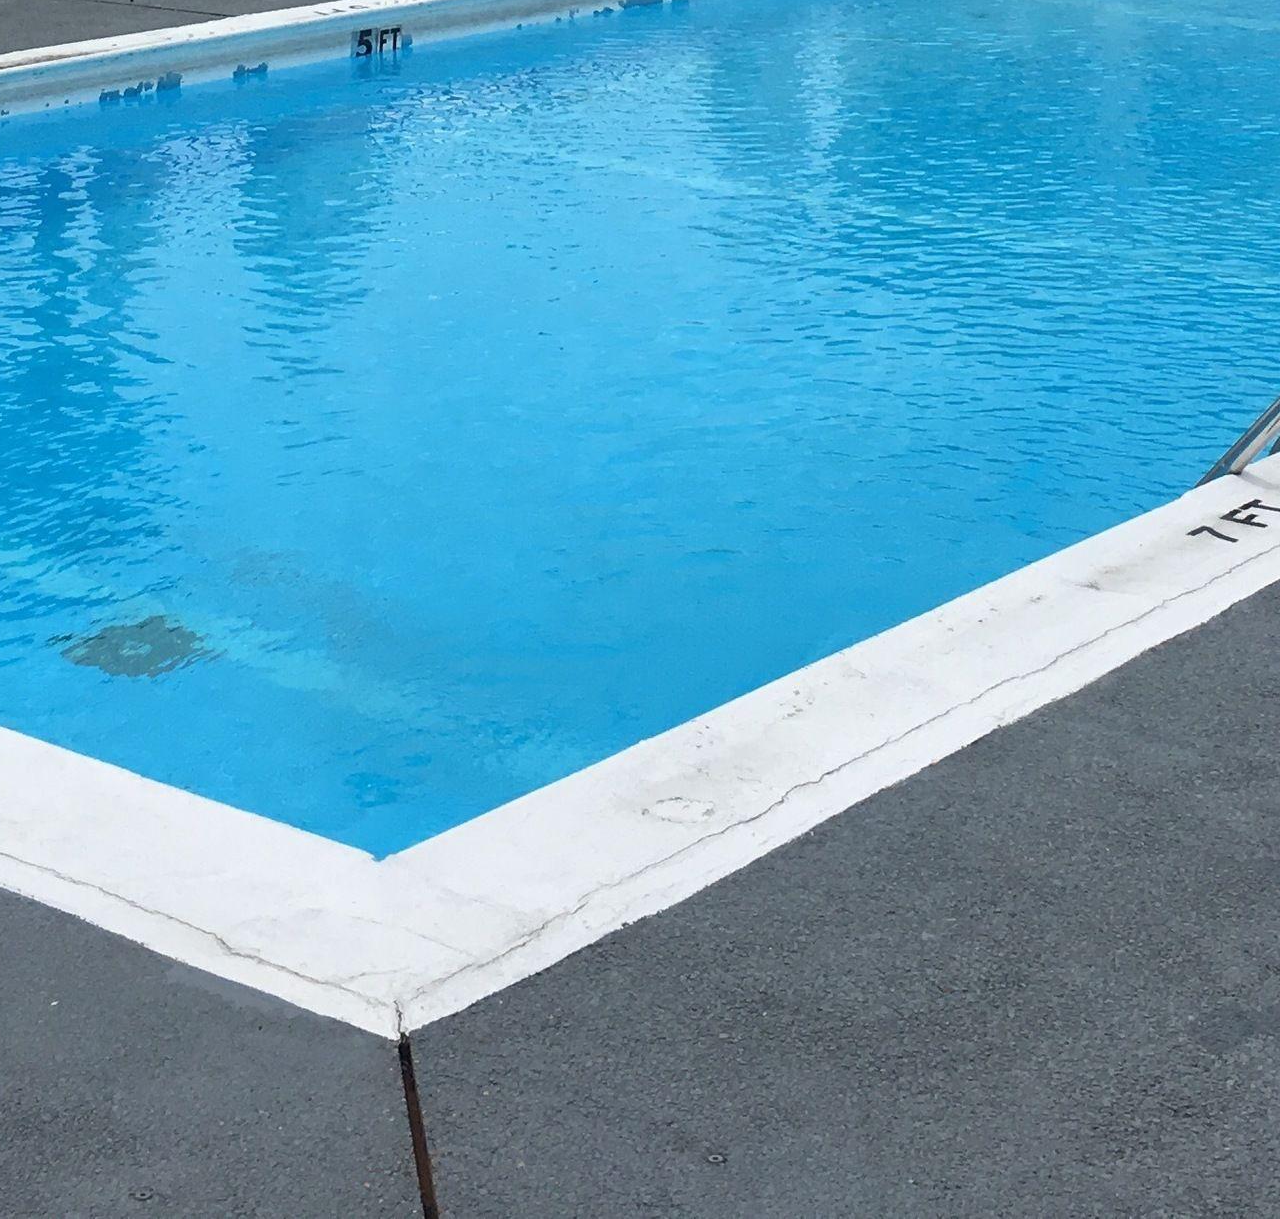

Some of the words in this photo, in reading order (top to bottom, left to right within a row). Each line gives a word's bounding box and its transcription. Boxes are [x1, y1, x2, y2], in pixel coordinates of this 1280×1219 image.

[356, 29, 372, 57] 5
[379, 27, 401, 53] FT
[1185, 525, 1240, 543] 7
